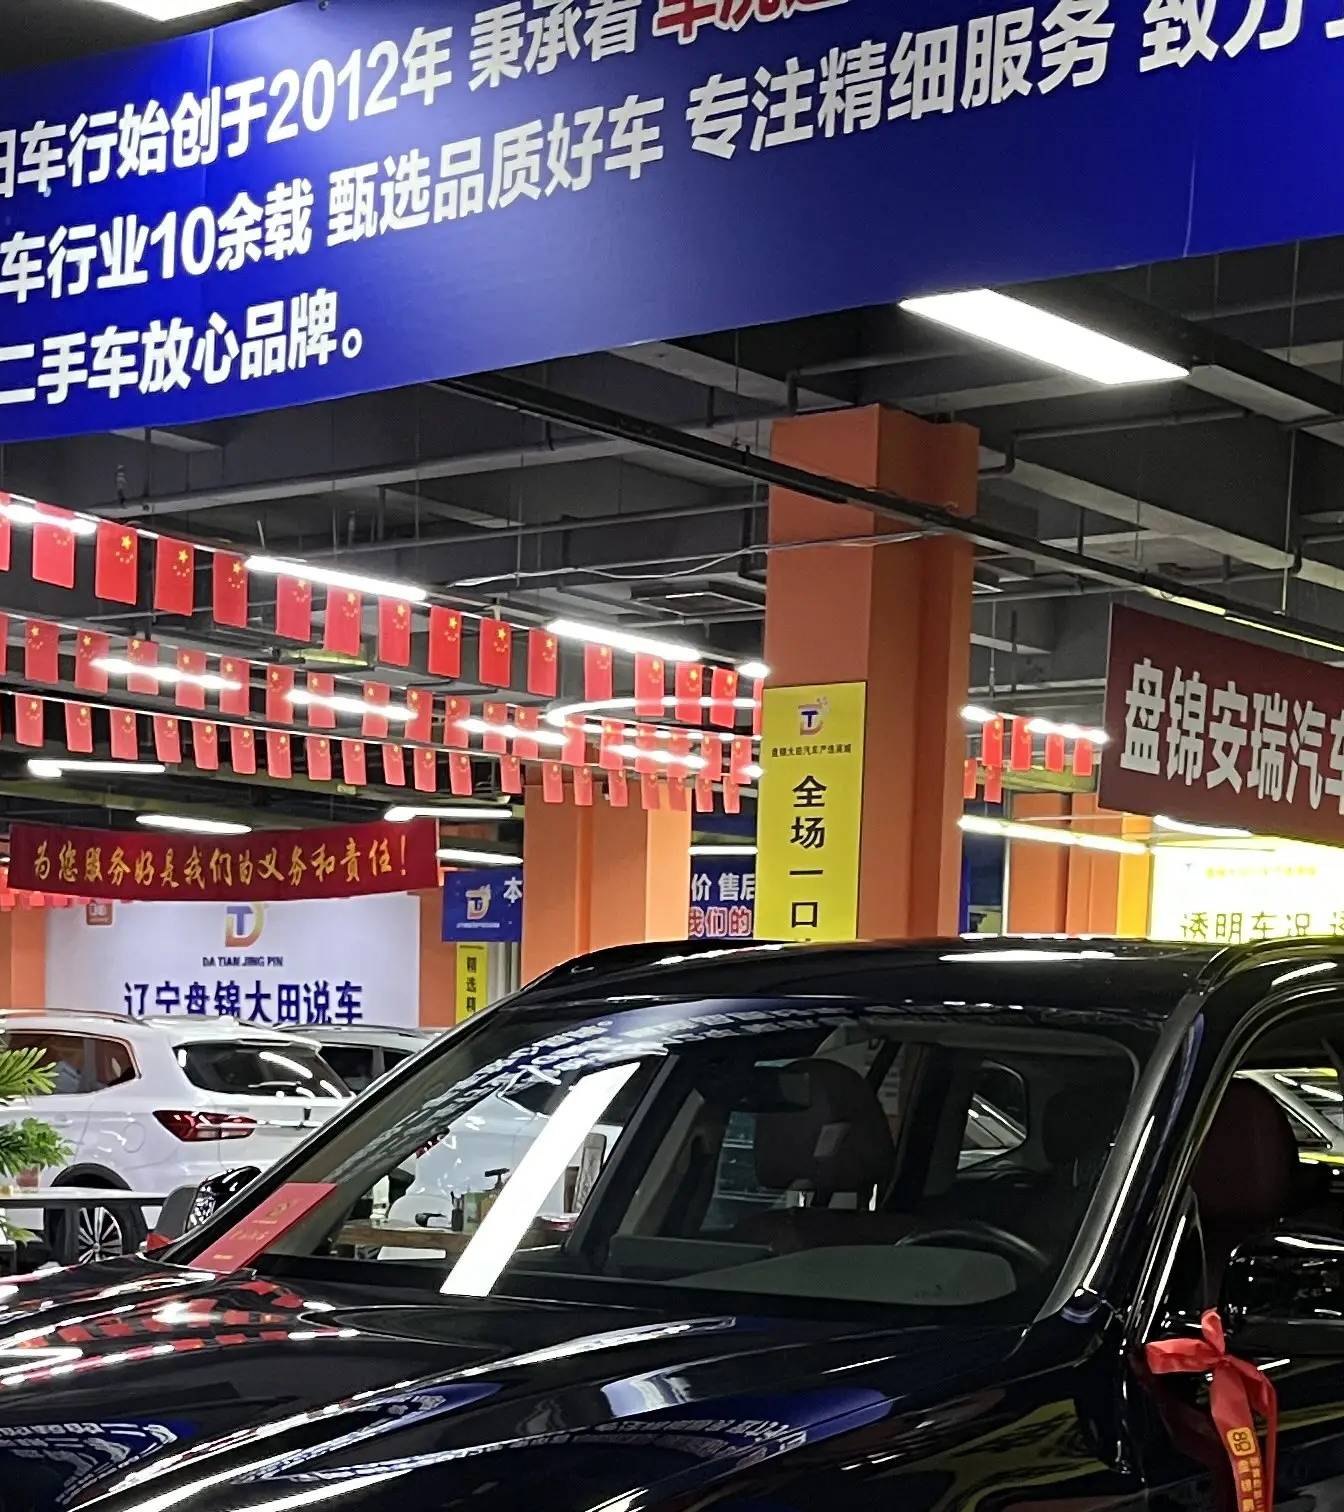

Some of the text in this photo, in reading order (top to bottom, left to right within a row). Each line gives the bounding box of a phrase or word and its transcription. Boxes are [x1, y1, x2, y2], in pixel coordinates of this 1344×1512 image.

[326, 94, 665, 247] 甄选品质好车
[686, 0, 1115, 160] 专注精细服务
[469, 0, 638, 92] 秉承着
